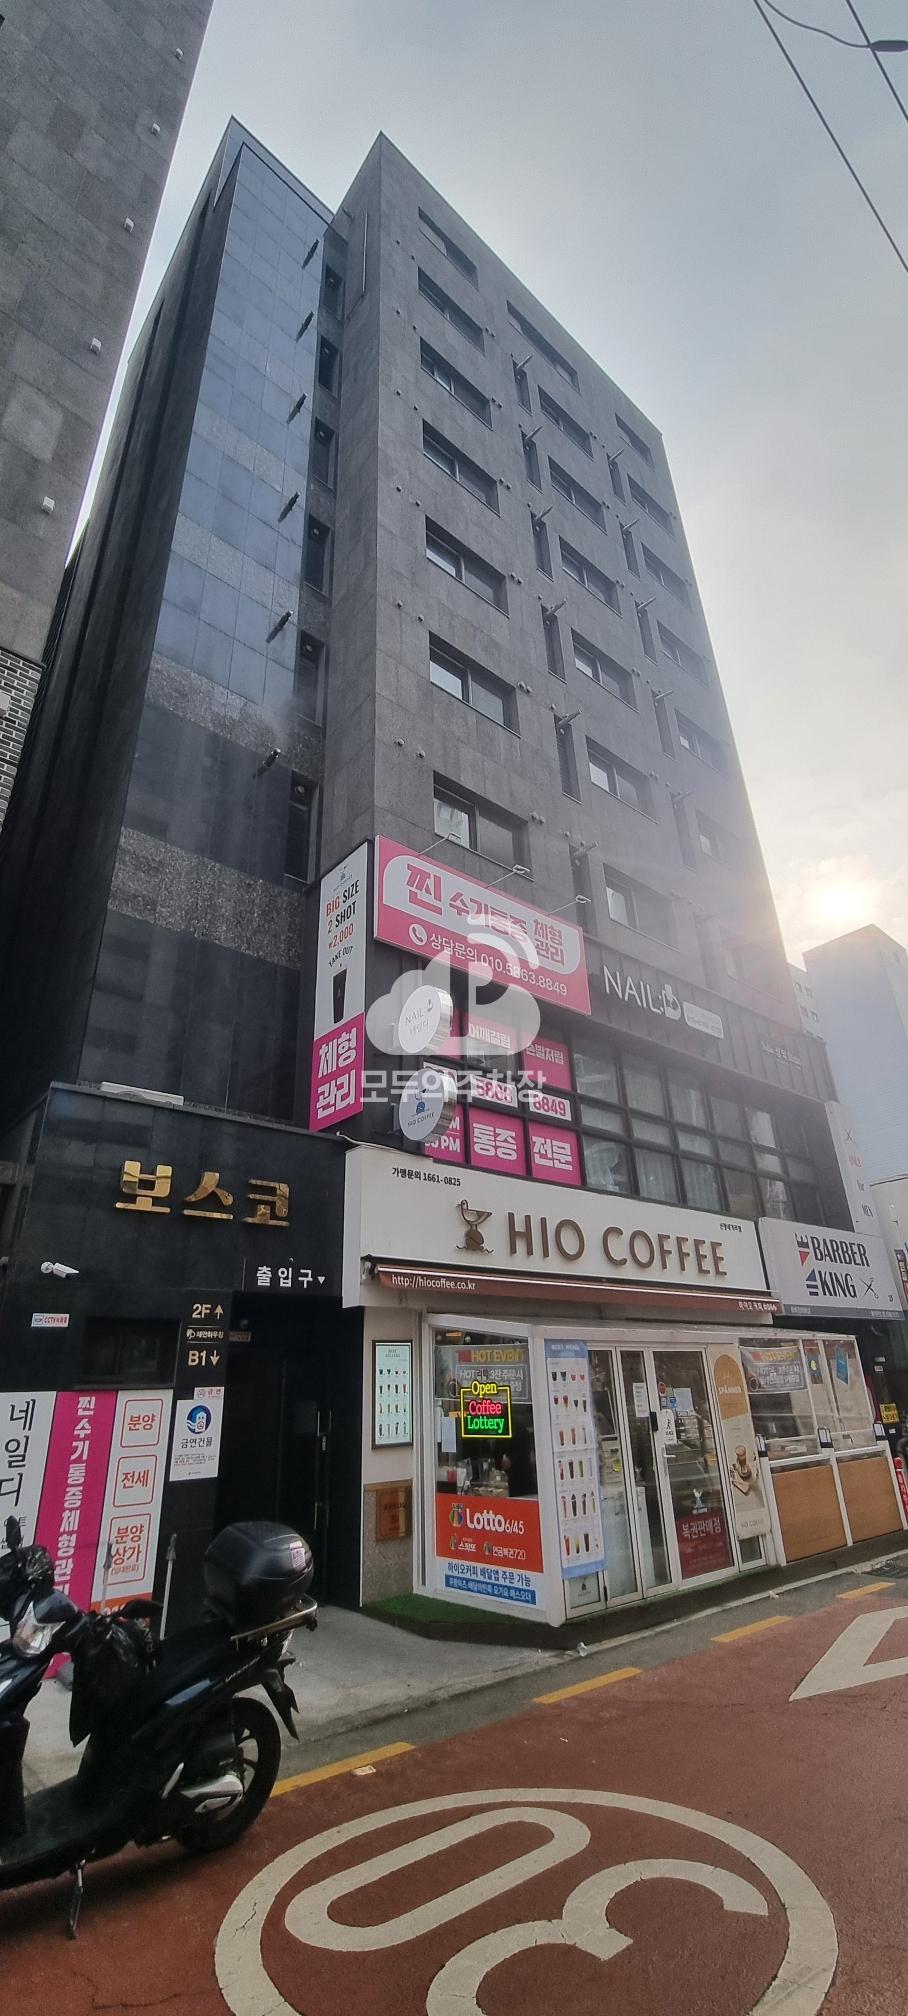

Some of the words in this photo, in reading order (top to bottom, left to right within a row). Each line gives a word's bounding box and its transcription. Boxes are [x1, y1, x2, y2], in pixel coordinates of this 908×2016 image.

[326, 895, 340, 917] BIG
[342, 879, 360, 904] SIZE
[406, 863, 444, 917] 찐
[449, 891, 529, 944] 수기통증
[533, 918, 563, 946] 체형
[327, 919, 334, 935] 2
[335, 900, 357, 928] SHOT
[328, 949, 341, 968] TAKE
[342, 945, 354, 959] OUT
[430, 933, 478, 966] 상담문의
[534, 939, 565, 966] 관리
[318, 1027, 357, 1079] 체형
[316, 1069, 356, 1121] 관리
[533, 1094, 566, 1117] 8849
[441, 1135, 461, 1153] PM
[473, 1122, 517, 1160] 통증
[533, 1136, 573, 1171] 전문
[392, 1166, 422, 1180] 가맹문의
[423, 1172, 461, 1187] 1661-0825
[113, 1159, 291, 1227] 보스코
[508, 1211, 585, 1261] HIO
[602, 1226, 728, 1276] COFFEE
[810, 1235, 870, 1268] BARBER
[256, 1264, 314, 1288] 출입구
[391, 1273, 477, 1291] http://hiocoffee.co.kr
[818, 1269, 858, 1300] KING
[191, 1303, 212, 1319] 2F
[187, 1349, 207, 1367] B1
[471, 1380, 498, 1398] Open
[468, 1399, 501, 1415] Coffee
[128, 1413, 157, 1432] 분양
[467, 1415, 505, 1433] Lottery
[180, 1436, 214, 1449] 금연건물
[121, 1468, 150, 1490] 전세
[115, 1523, 146, 1543] 분양
[466, 1507, 505, 1533] Lotto
[505, 1519, 525, 1535] 6/45
[682, 1516, 722, 1540] 복권판매점
[111, 1543, 142, 1566] 상가
[447, 1561, 479, 1578] 하이오커피
[502, 1570, 516, 1585] 주문
[517, 1573, 532, 1588] 가능
